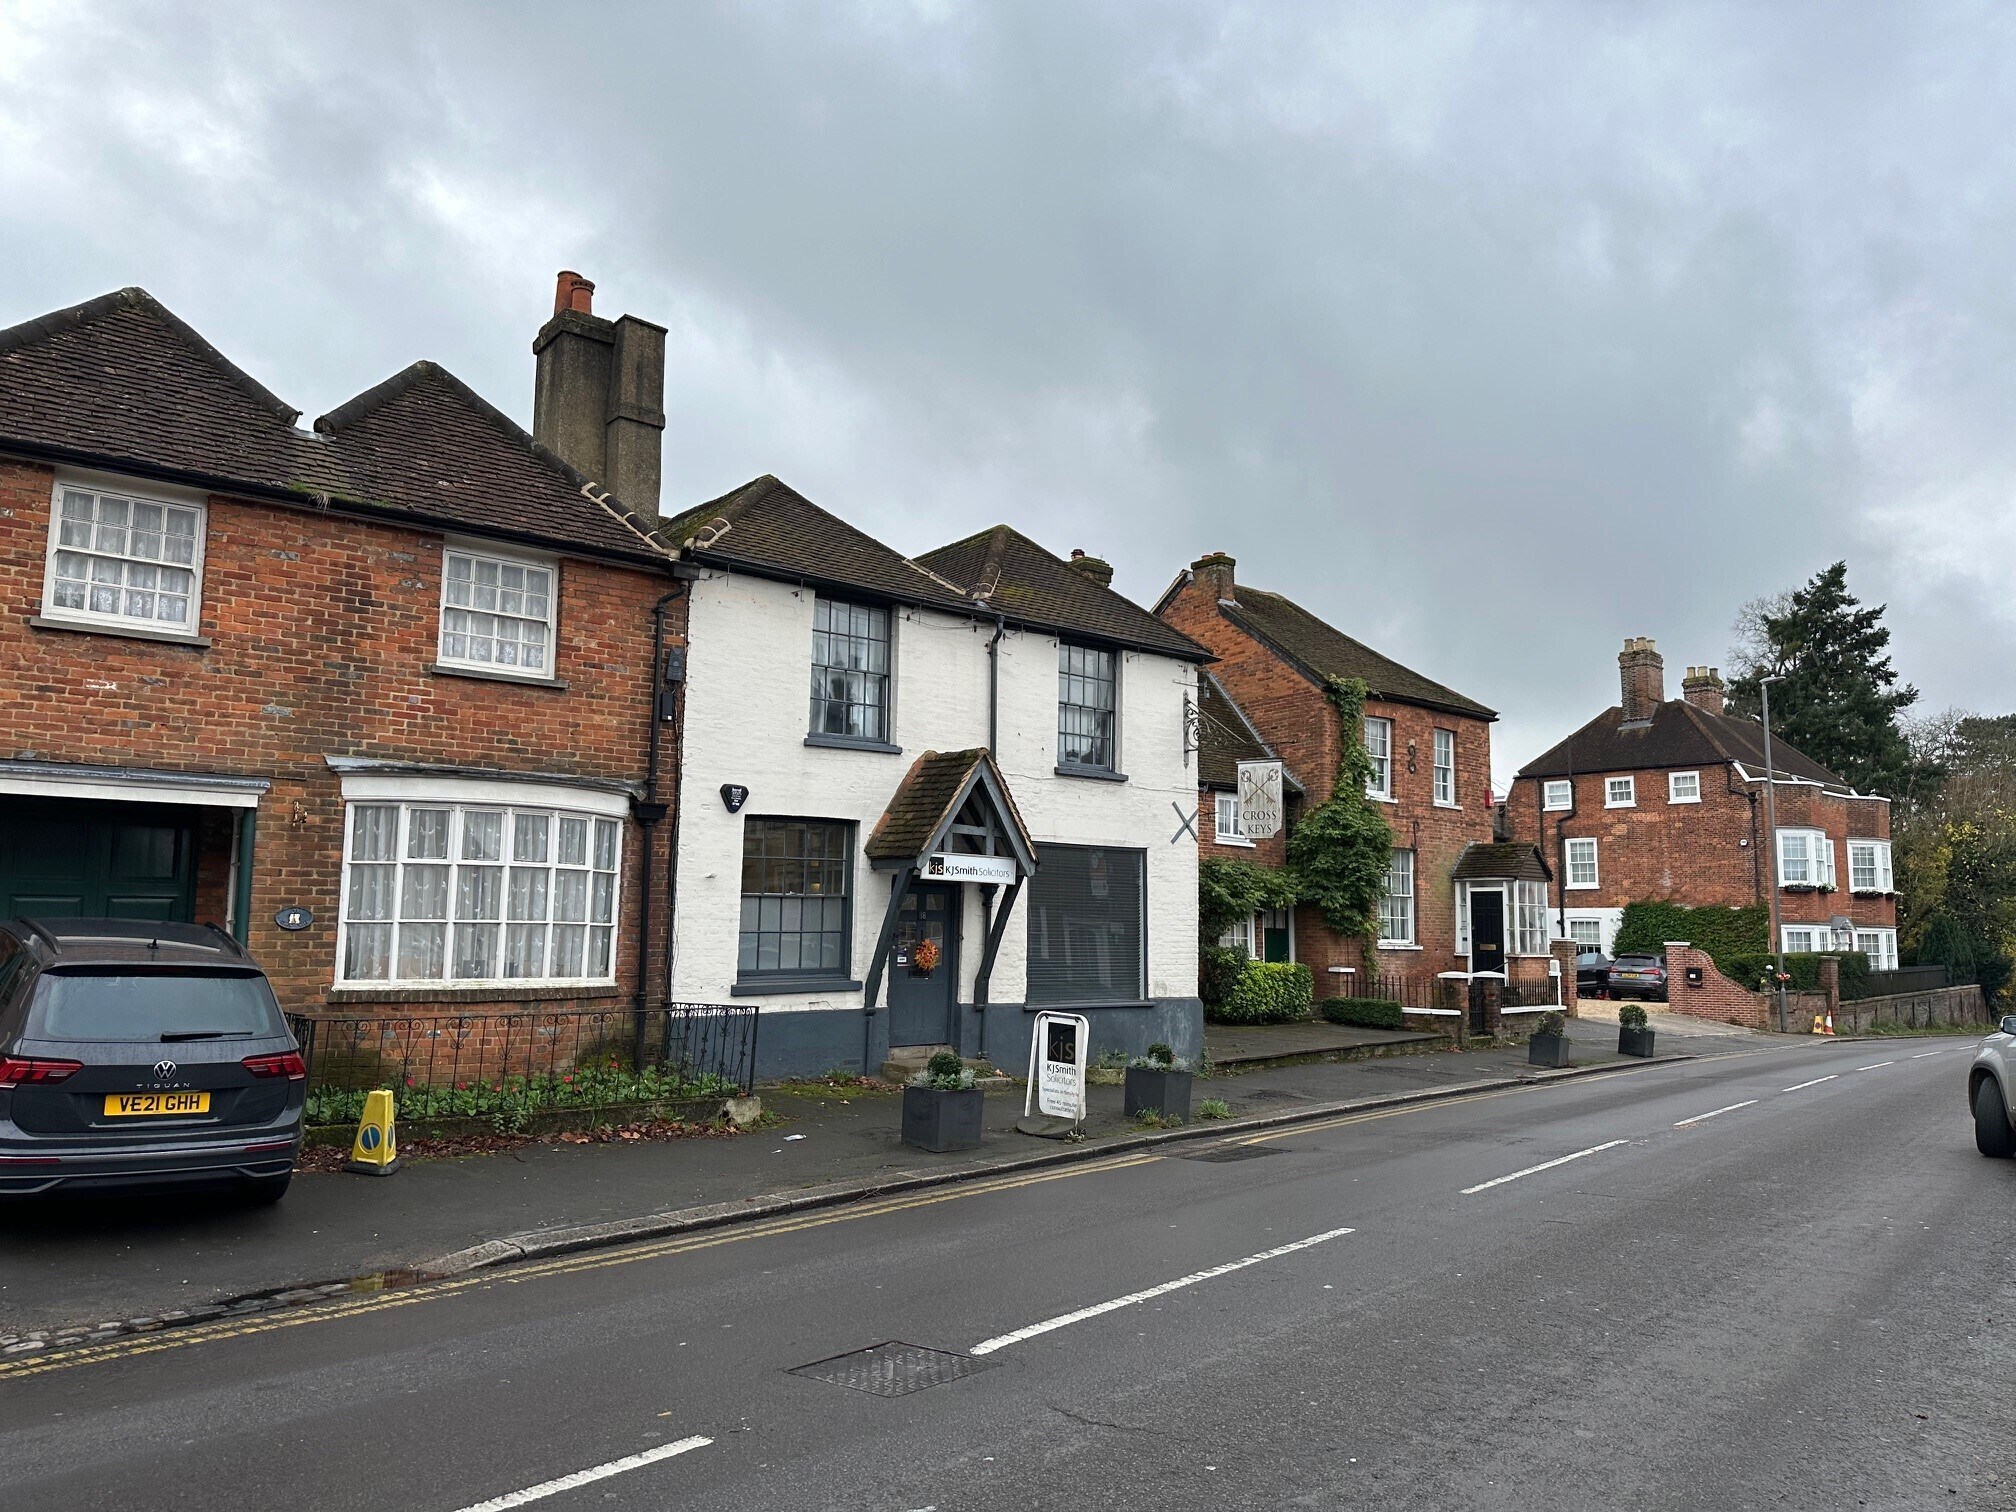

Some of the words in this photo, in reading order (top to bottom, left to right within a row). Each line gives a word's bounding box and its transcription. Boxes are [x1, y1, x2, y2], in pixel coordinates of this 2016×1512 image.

[1242, 810, 1277, 821] CROSS
[1247, 824, 1272, 834] KEYS
[929, 860, 943, 875] kjs
[979, 867, 1010, 878] Solicitors
[1048, 1032, 1074, 1062] kjs
[1046, 1073, 1076, 1086] Solicitors
[119, 1095, 161, 1112] VE21
[165, 1094, 201, 1111] GHH
